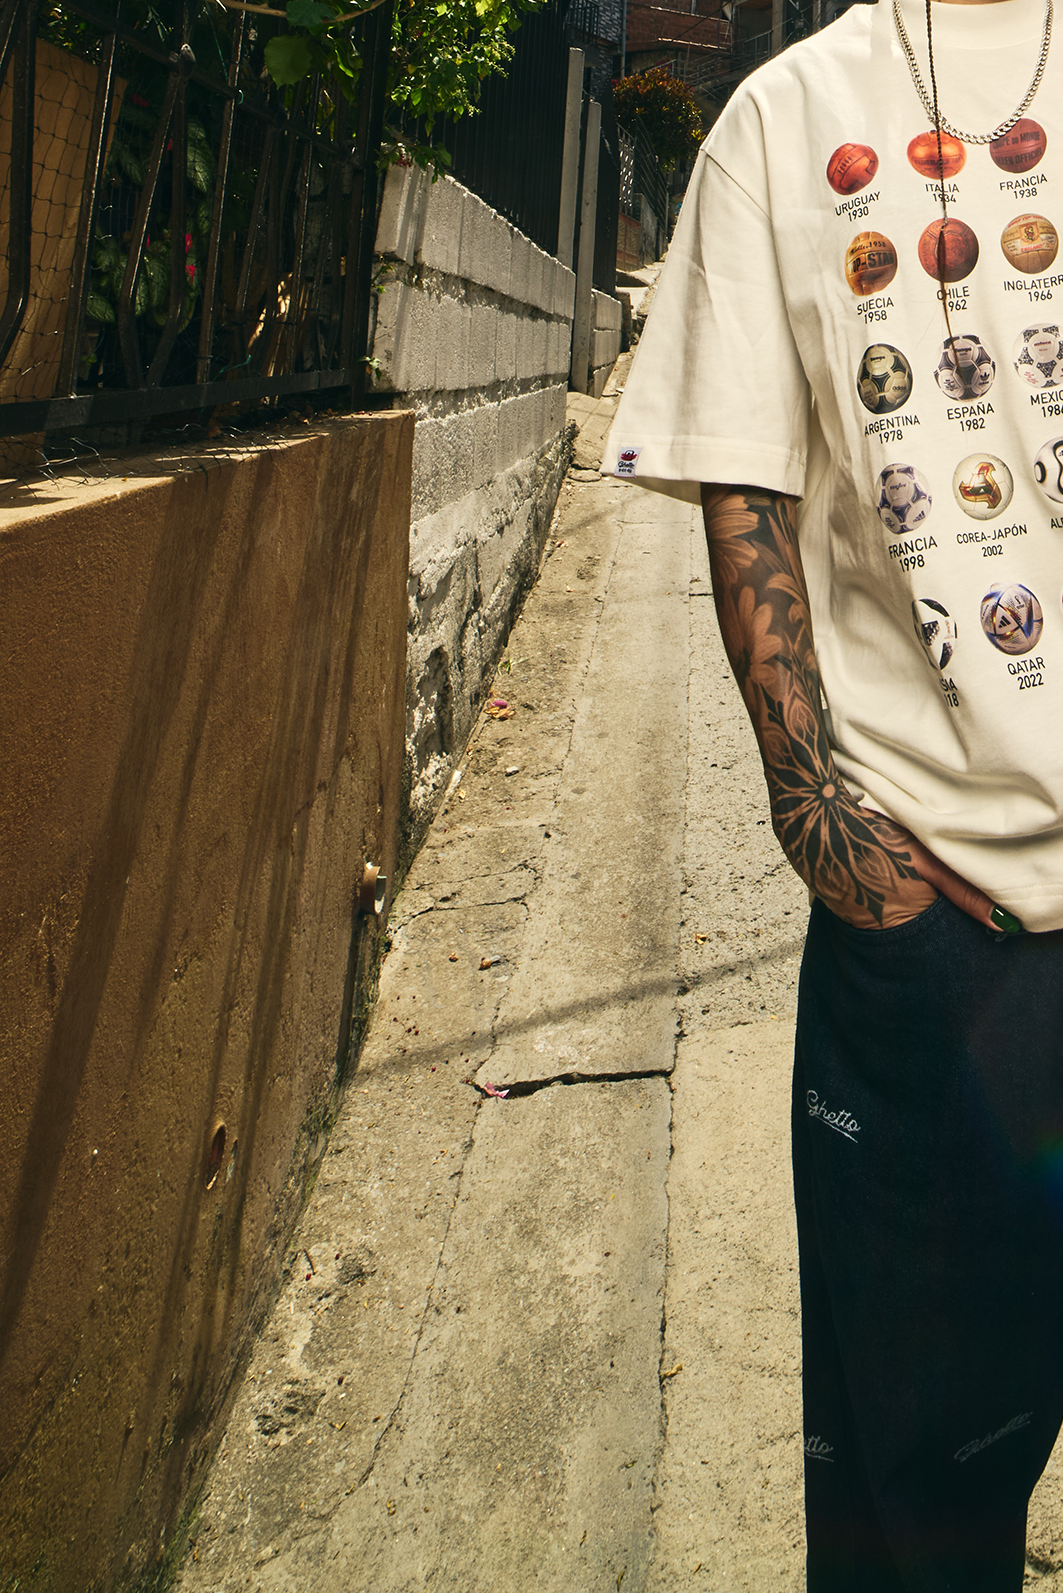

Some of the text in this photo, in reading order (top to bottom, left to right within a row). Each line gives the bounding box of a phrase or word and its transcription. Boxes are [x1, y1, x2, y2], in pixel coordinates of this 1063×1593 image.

[925, 183, 960, 193] ITALIA
[999, 174, 1048, 191] FRANCIA
[1013, 187, 1038, 199] 1938
[834, 191, 881, 216] URUGUAY
[848, 206, 869, 222] 1930
[936, 286, 970, 301] CHILE
[1028, 290, 1053, 302] 1966
[857, 297, 895, 315] SUECIA
[946, 299, 967, 311] 962
[864, 310, 888, 324] 1958
[946, 401, 995, 420] ESPAÑA
[864, 414, 920, 437] ARGENTINA
[960, 417, 986, 432] 1982
[879, 429, 904, 444] 1978
[956, 523, 1028, 545] COREA-JAPÓN
[888, 536, 938, 559] FRANCIA
[981, 544, 1004, 557] 2002
[899, 554, 925, 573] 1998
[1007, 656, 1046, 676] QATAR
[939, 677, 959, 692] SIA
[1017, 672, 1044, 690] 2022
[806, 1089, 862, 1141] Ghetto
